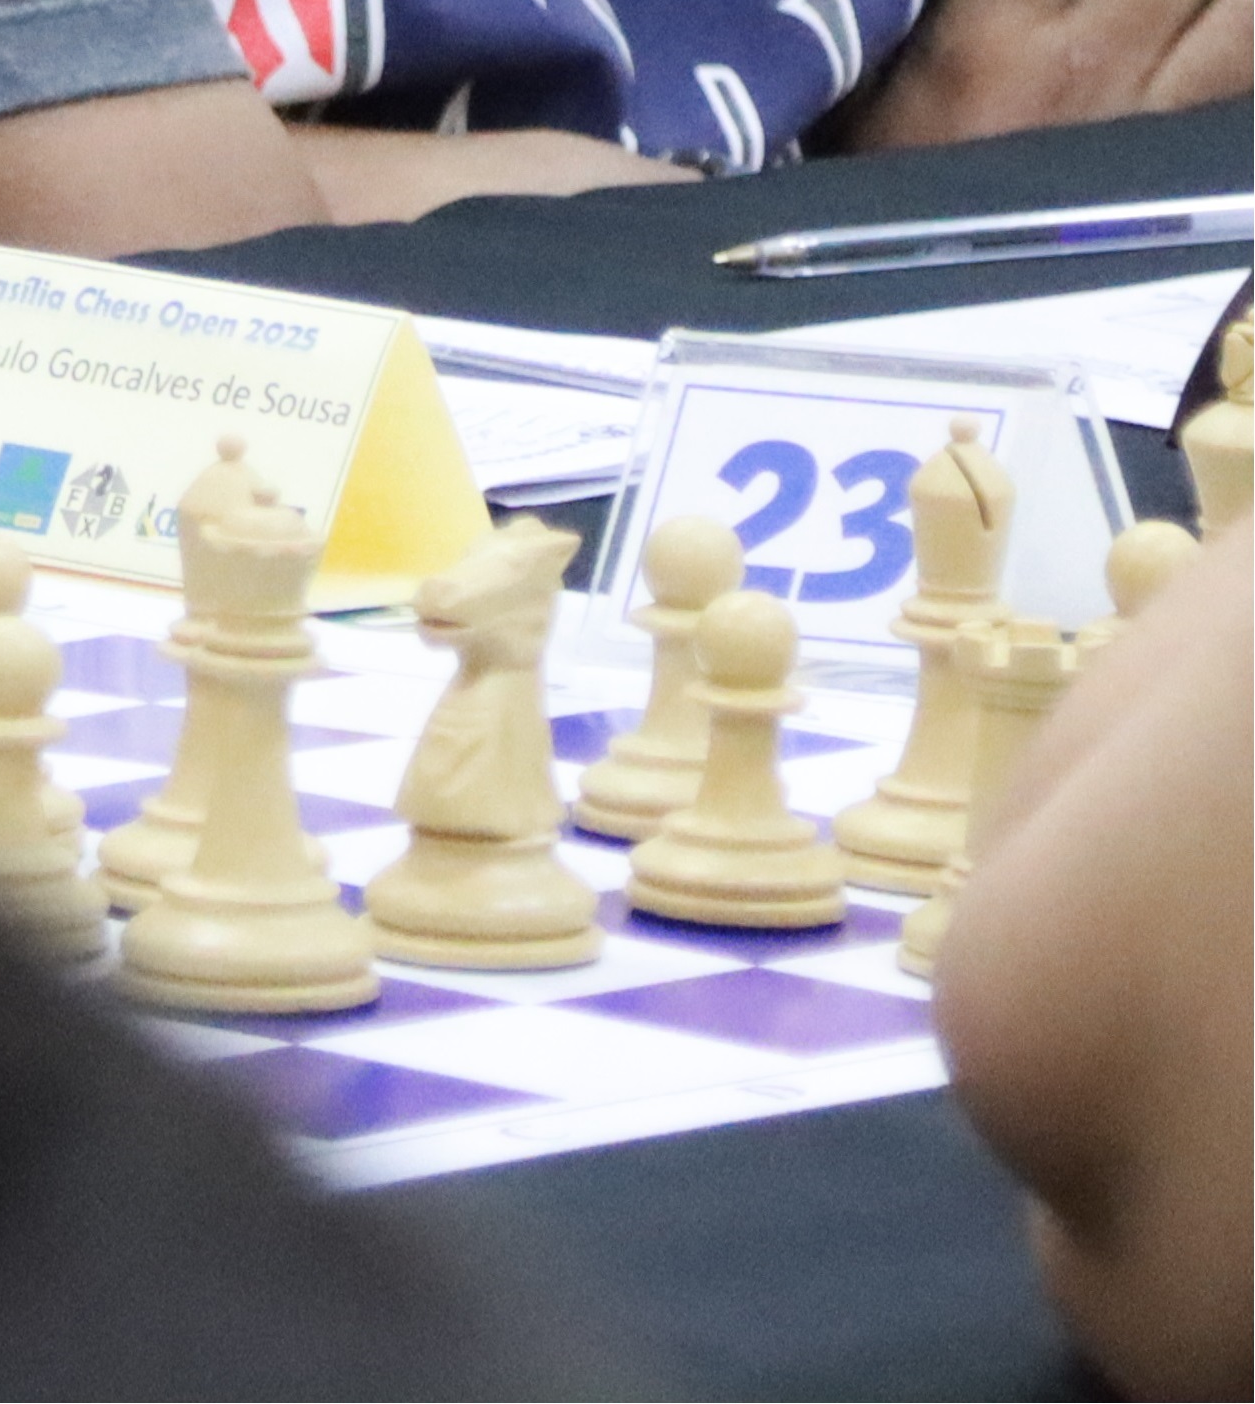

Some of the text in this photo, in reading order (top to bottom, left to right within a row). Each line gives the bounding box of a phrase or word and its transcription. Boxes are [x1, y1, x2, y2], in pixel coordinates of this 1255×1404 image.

[75, 286, 151, 324] Chess
[159, 300, 238, 337] Open
[244, 318, 320, 351] 2025
[48, 348, 204, 402] Goncalves
[212, 374, 250, 409] de
[259, 382, 352, 426] Sousa
[717, 439, 922, 603] 23
